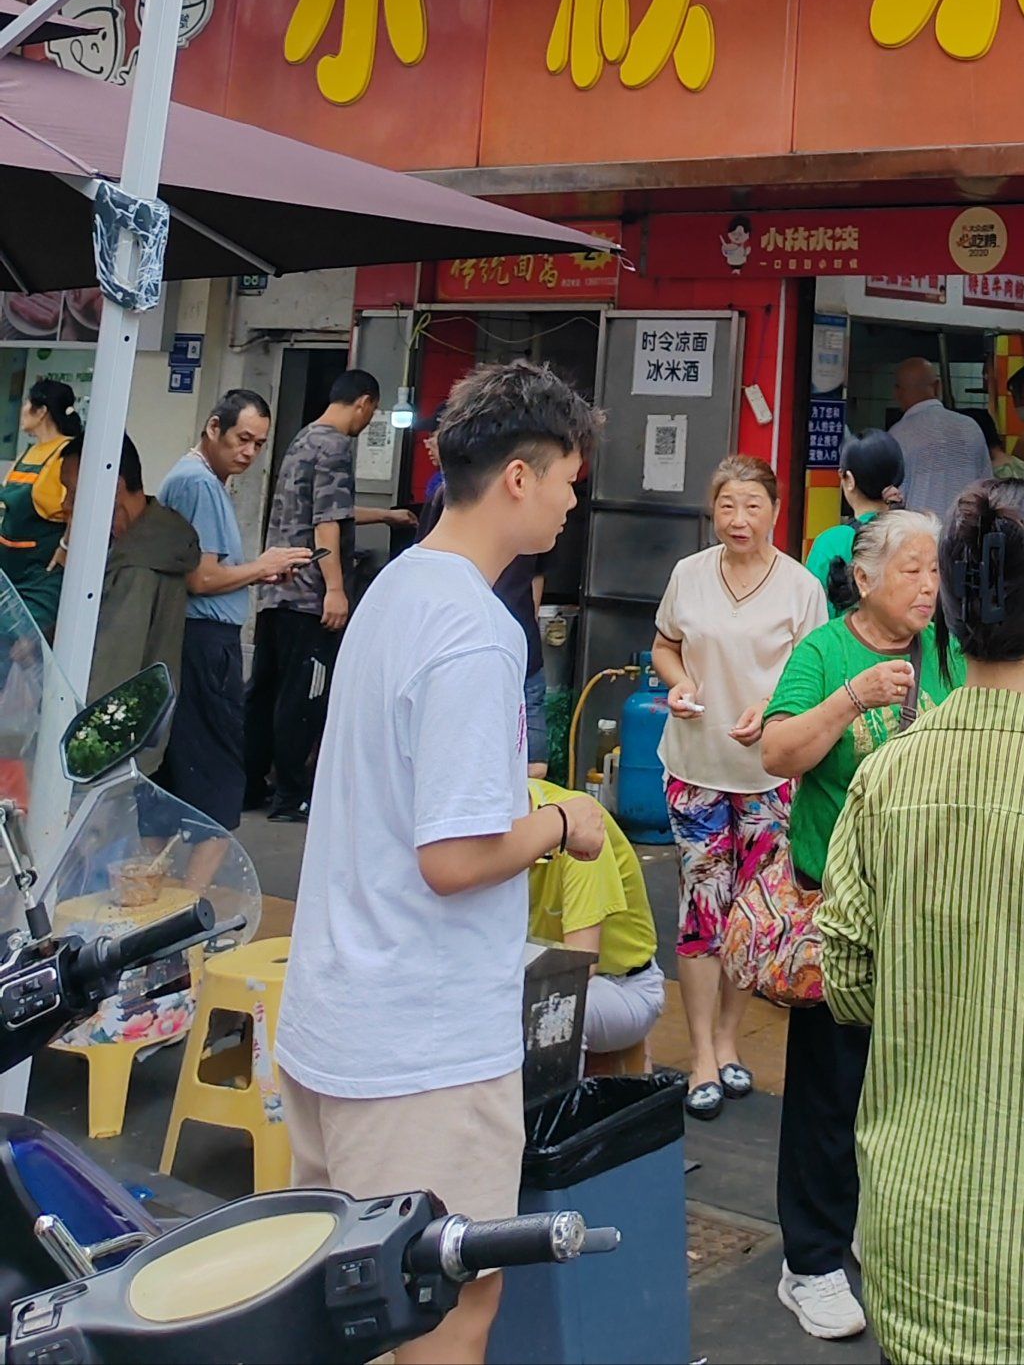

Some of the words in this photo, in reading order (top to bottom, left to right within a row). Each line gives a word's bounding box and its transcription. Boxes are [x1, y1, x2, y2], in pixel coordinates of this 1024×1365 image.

[760, 225, 859, 252] 小秋水饺
[641, 331, 709, 352] 时令凉面
[646, 359, 700, 382] 冰米酒
